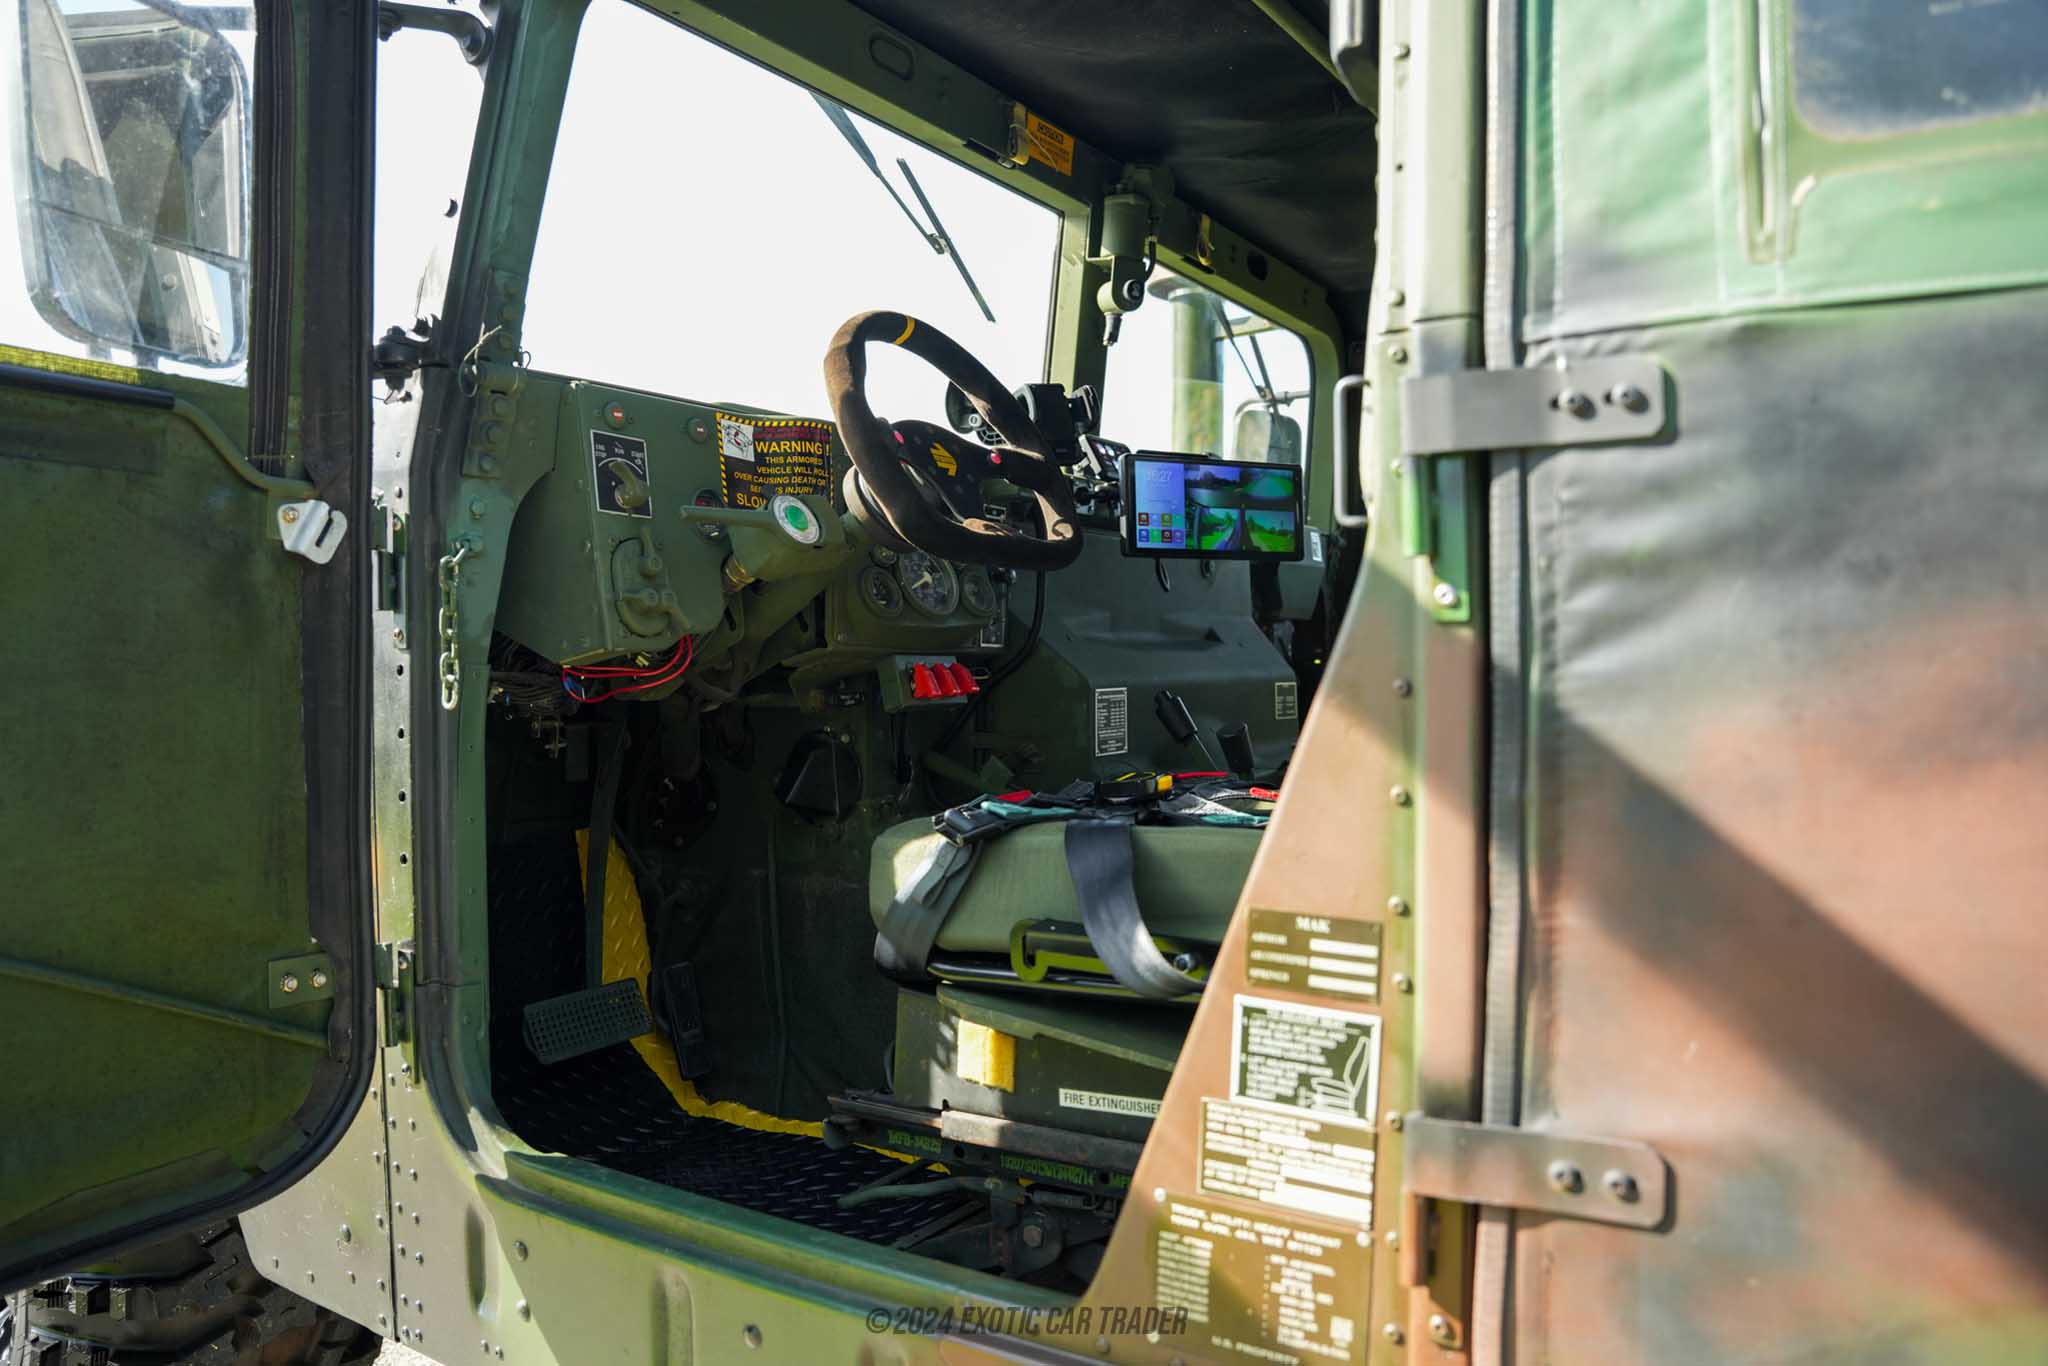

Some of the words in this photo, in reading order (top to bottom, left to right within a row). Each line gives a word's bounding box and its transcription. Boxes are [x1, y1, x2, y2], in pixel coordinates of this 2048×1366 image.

[755, 441, 823, 454] WARNING
[765, 456, 784, 464] THIS
[786, 456, 823, 465] ARMORED
[734, 471, 753, 481] OVER
[753, 475, 790, 484] CAUSING
[791, 475, 816, 484] DEATH
[756, 466, 792, 474] VEHICLE
[793, 466, 813, 474] WILL
[813, 467, 830, 477] ROLL
[785, 486, 814, 495] INJURY
[1063, 1091, 1086, 1105] FIRE
